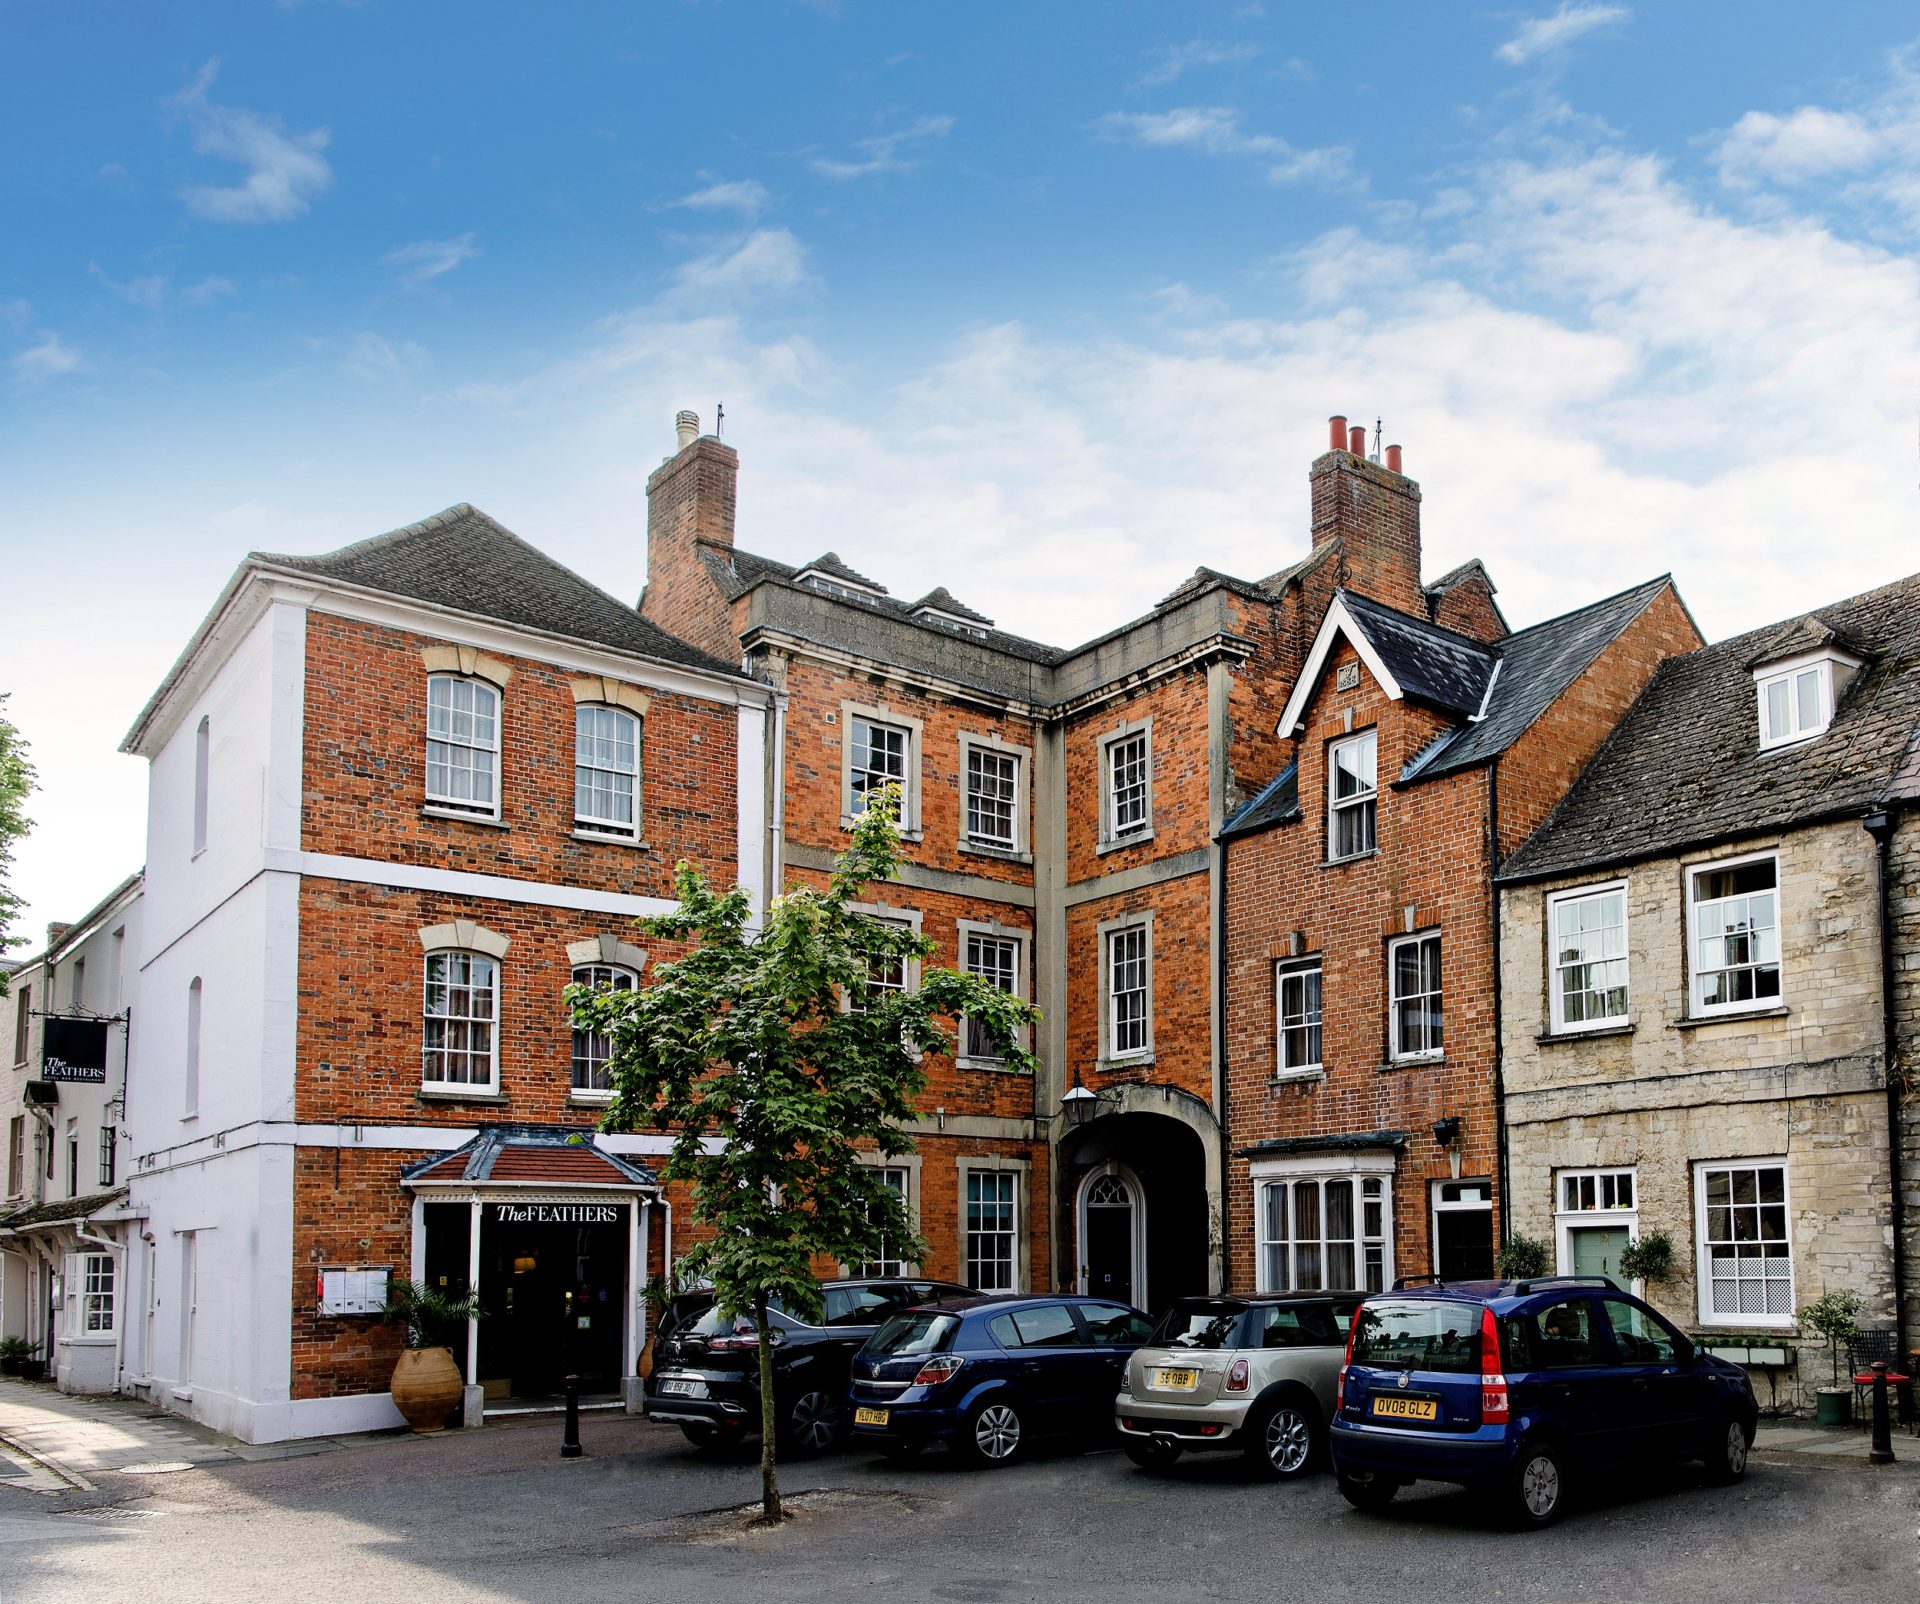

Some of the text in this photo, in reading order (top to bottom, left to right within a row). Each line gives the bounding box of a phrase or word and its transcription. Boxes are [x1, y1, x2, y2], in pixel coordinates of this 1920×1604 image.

[46, 1057, 67, 1067] The
[44, 1066, 105, 1078] FEATHERS
[1378, 1399, 1432, 1416] OV08 GLZ
